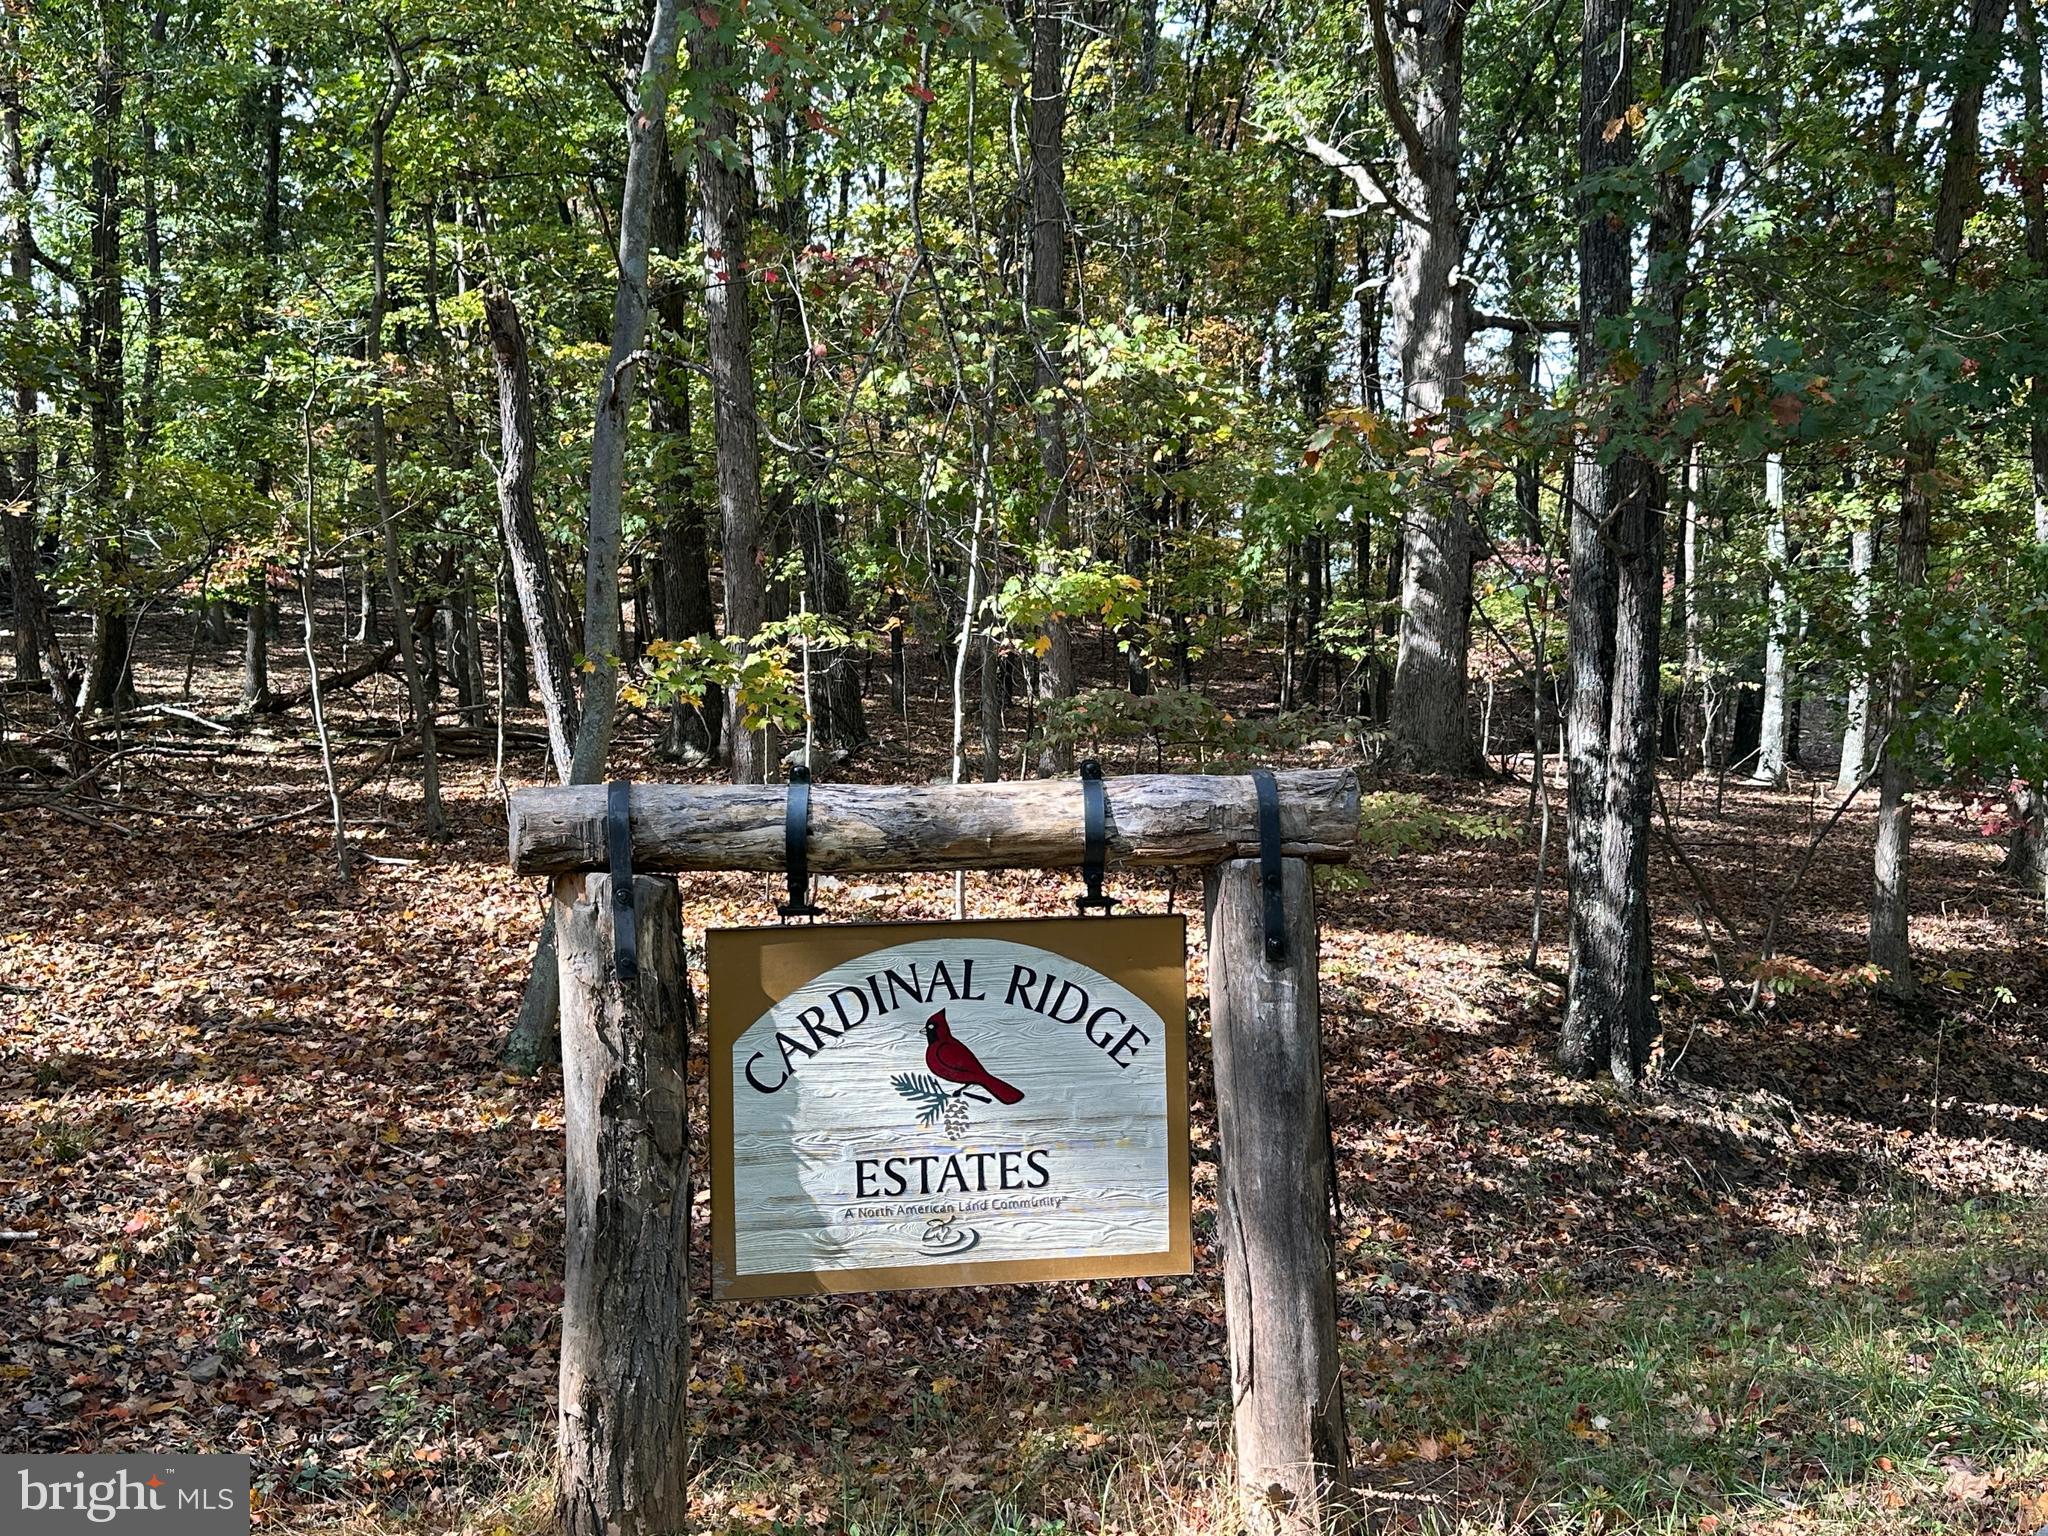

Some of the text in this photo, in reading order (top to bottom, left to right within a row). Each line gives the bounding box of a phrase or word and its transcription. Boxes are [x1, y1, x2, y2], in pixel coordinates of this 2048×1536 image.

[744, 959, 1151, 1094] CARDINAL RIDGE
[856, 1150, 1050, 1198] ESTATES
[844, 1208, 854, 1219] A
[858, 1205, 893, 1218] North
[897, 1202, 955, 1216] American
[958, 1199, 988, 1212] Land
